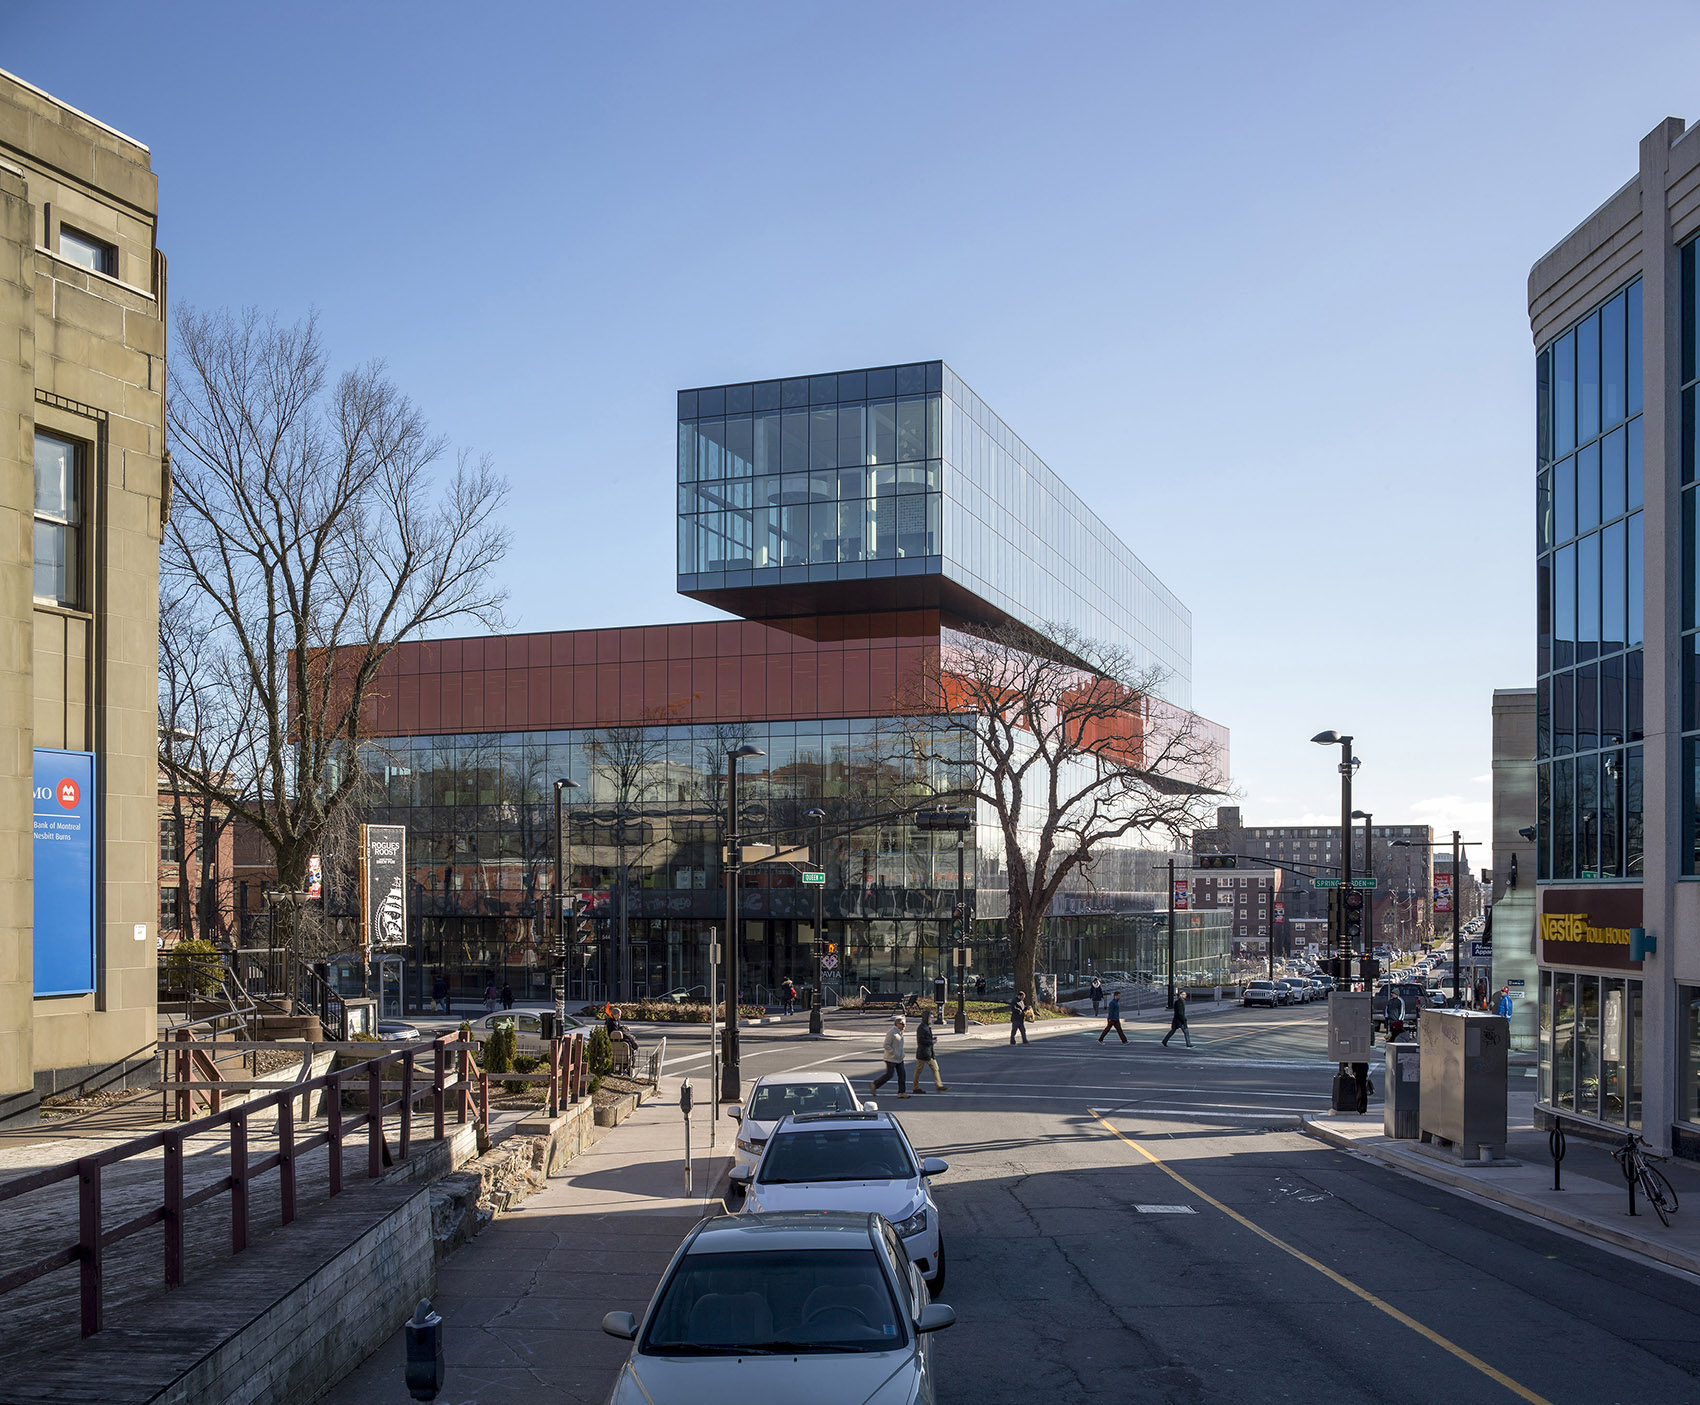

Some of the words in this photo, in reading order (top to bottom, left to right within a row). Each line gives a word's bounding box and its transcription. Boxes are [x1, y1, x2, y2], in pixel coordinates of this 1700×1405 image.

[33, 787, 52, 800] MO
[33, 821, 48, 829] Bank
[49, 821, 56, 829] of
[1605, 927, 1630, 944] HOUS
